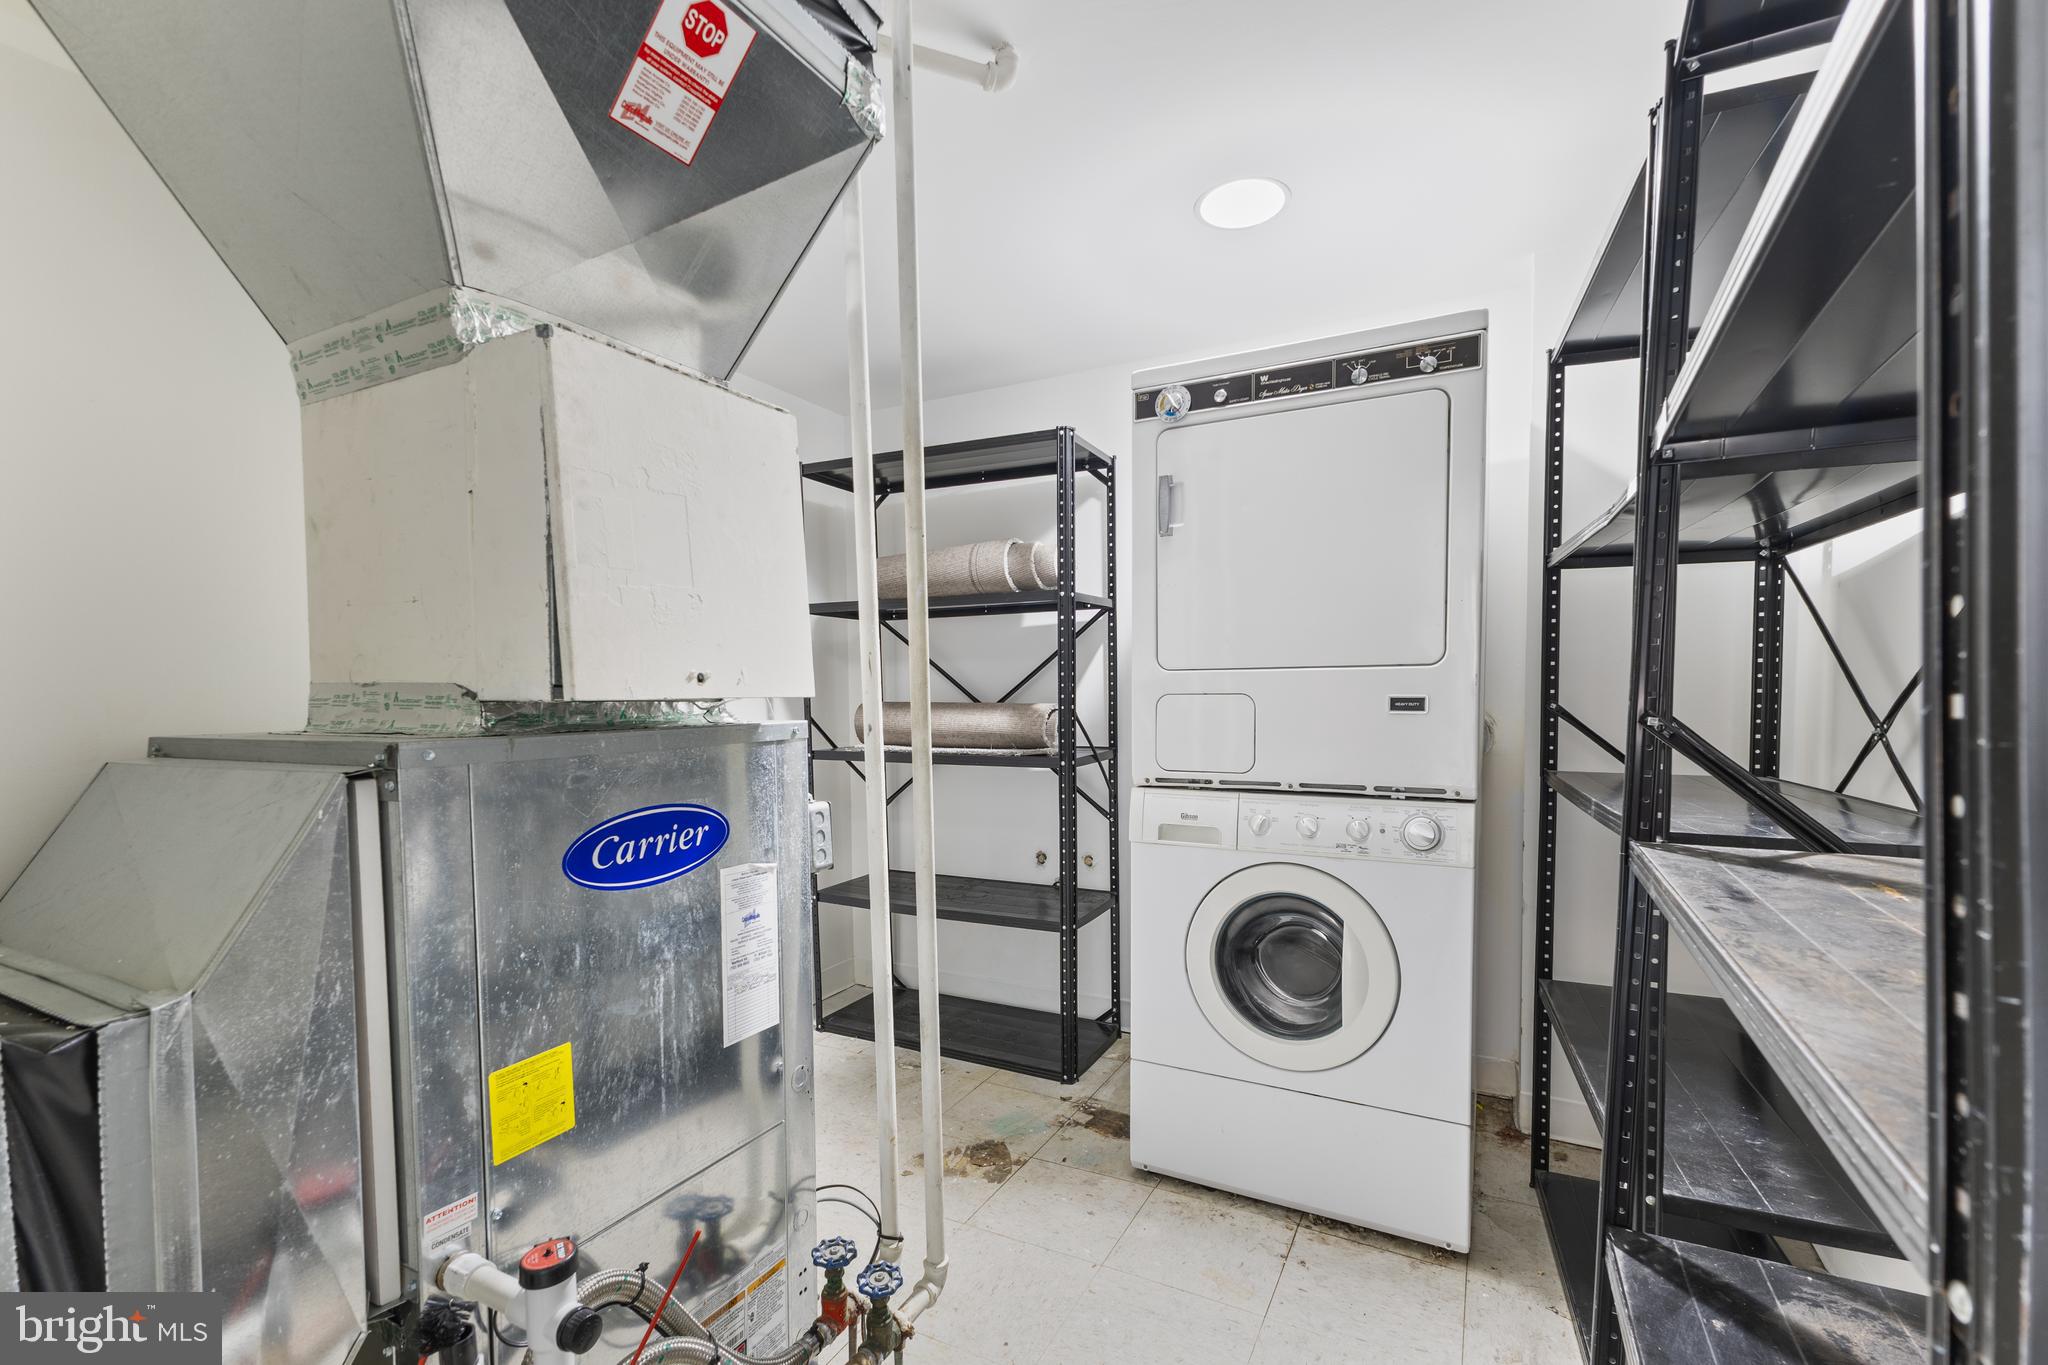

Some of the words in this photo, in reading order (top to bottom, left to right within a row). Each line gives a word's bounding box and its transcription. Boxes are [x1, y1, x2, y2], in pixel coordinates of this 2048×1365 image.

[685, 9, 725, 47] STOP
[662, 47, 681, 64] UNDER
[665, 40, 695, 64] EQUIPMENT
[694, 61, 707, 73] MAY
[1181, 812, 1198, 820] Gibson
[592, 824, 709, 870] Carrier
[426, 1196, 477, 1224] ATTENTION!
[431, 1226, 469, 1250] CONDENSATE
